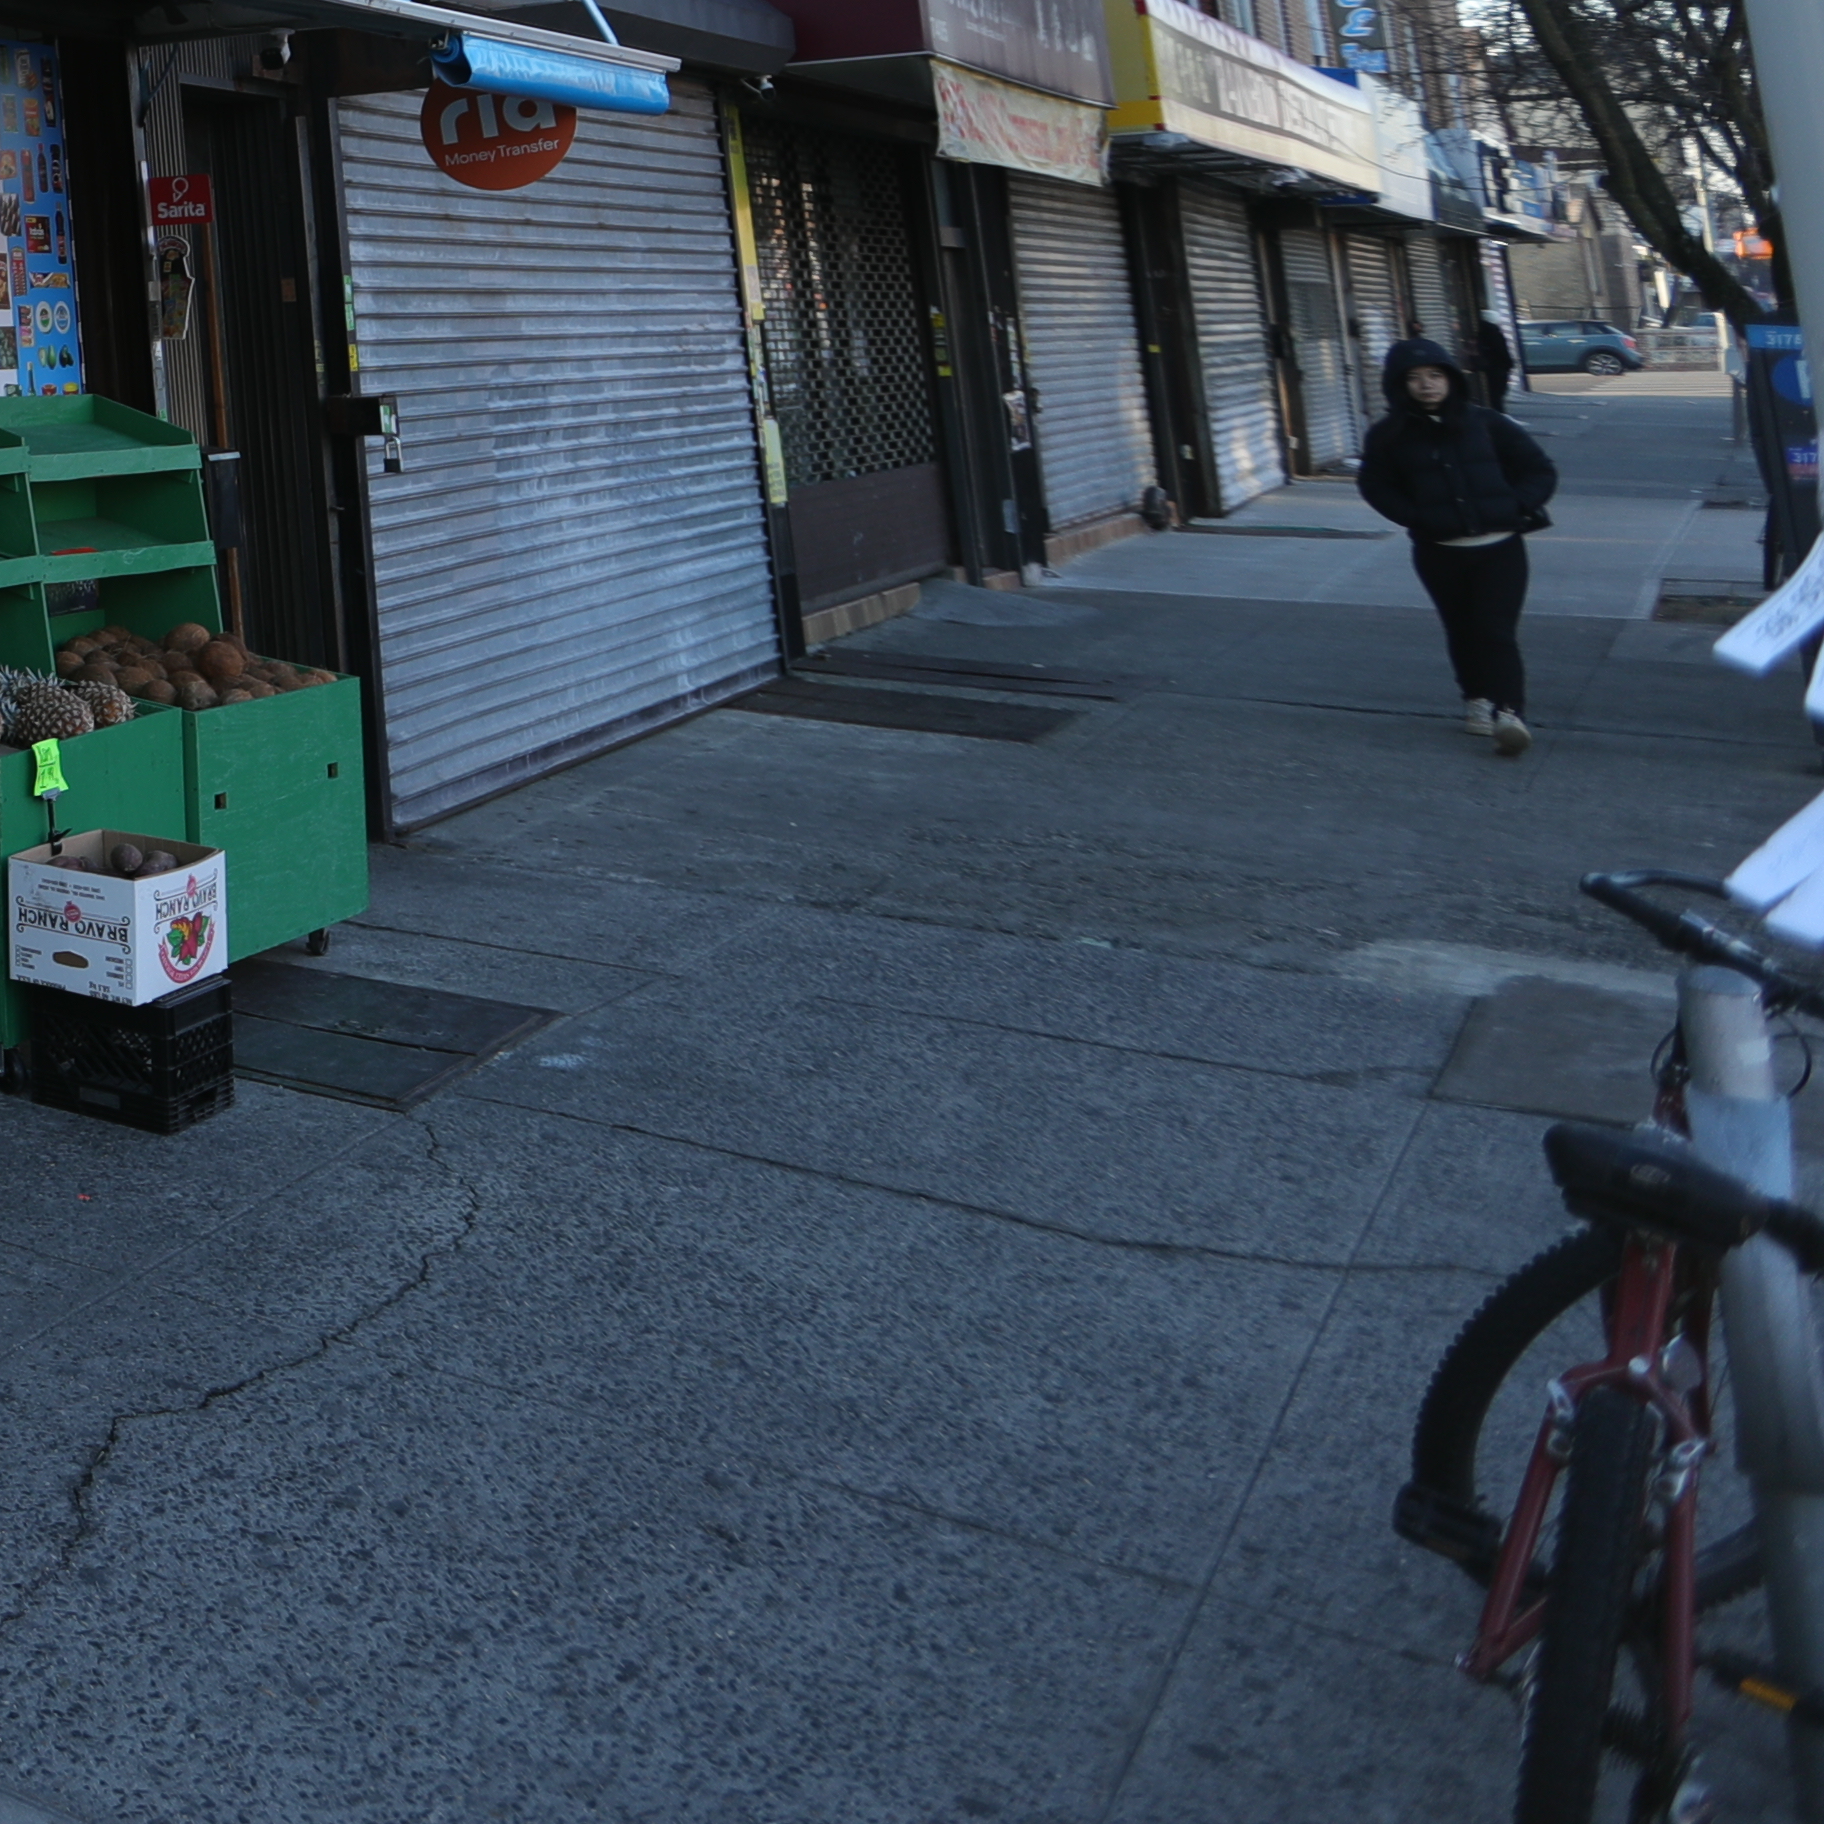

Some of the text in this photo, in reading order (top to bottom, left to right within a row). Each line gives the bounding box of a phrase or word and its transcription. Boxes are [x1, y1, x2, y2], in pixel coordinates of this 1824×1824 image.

[444, 136, 560, 167] Money Transfer
[157, 202, 206, 220] Sarita
[17, 906, 129, 943] BRAVO RANCH
